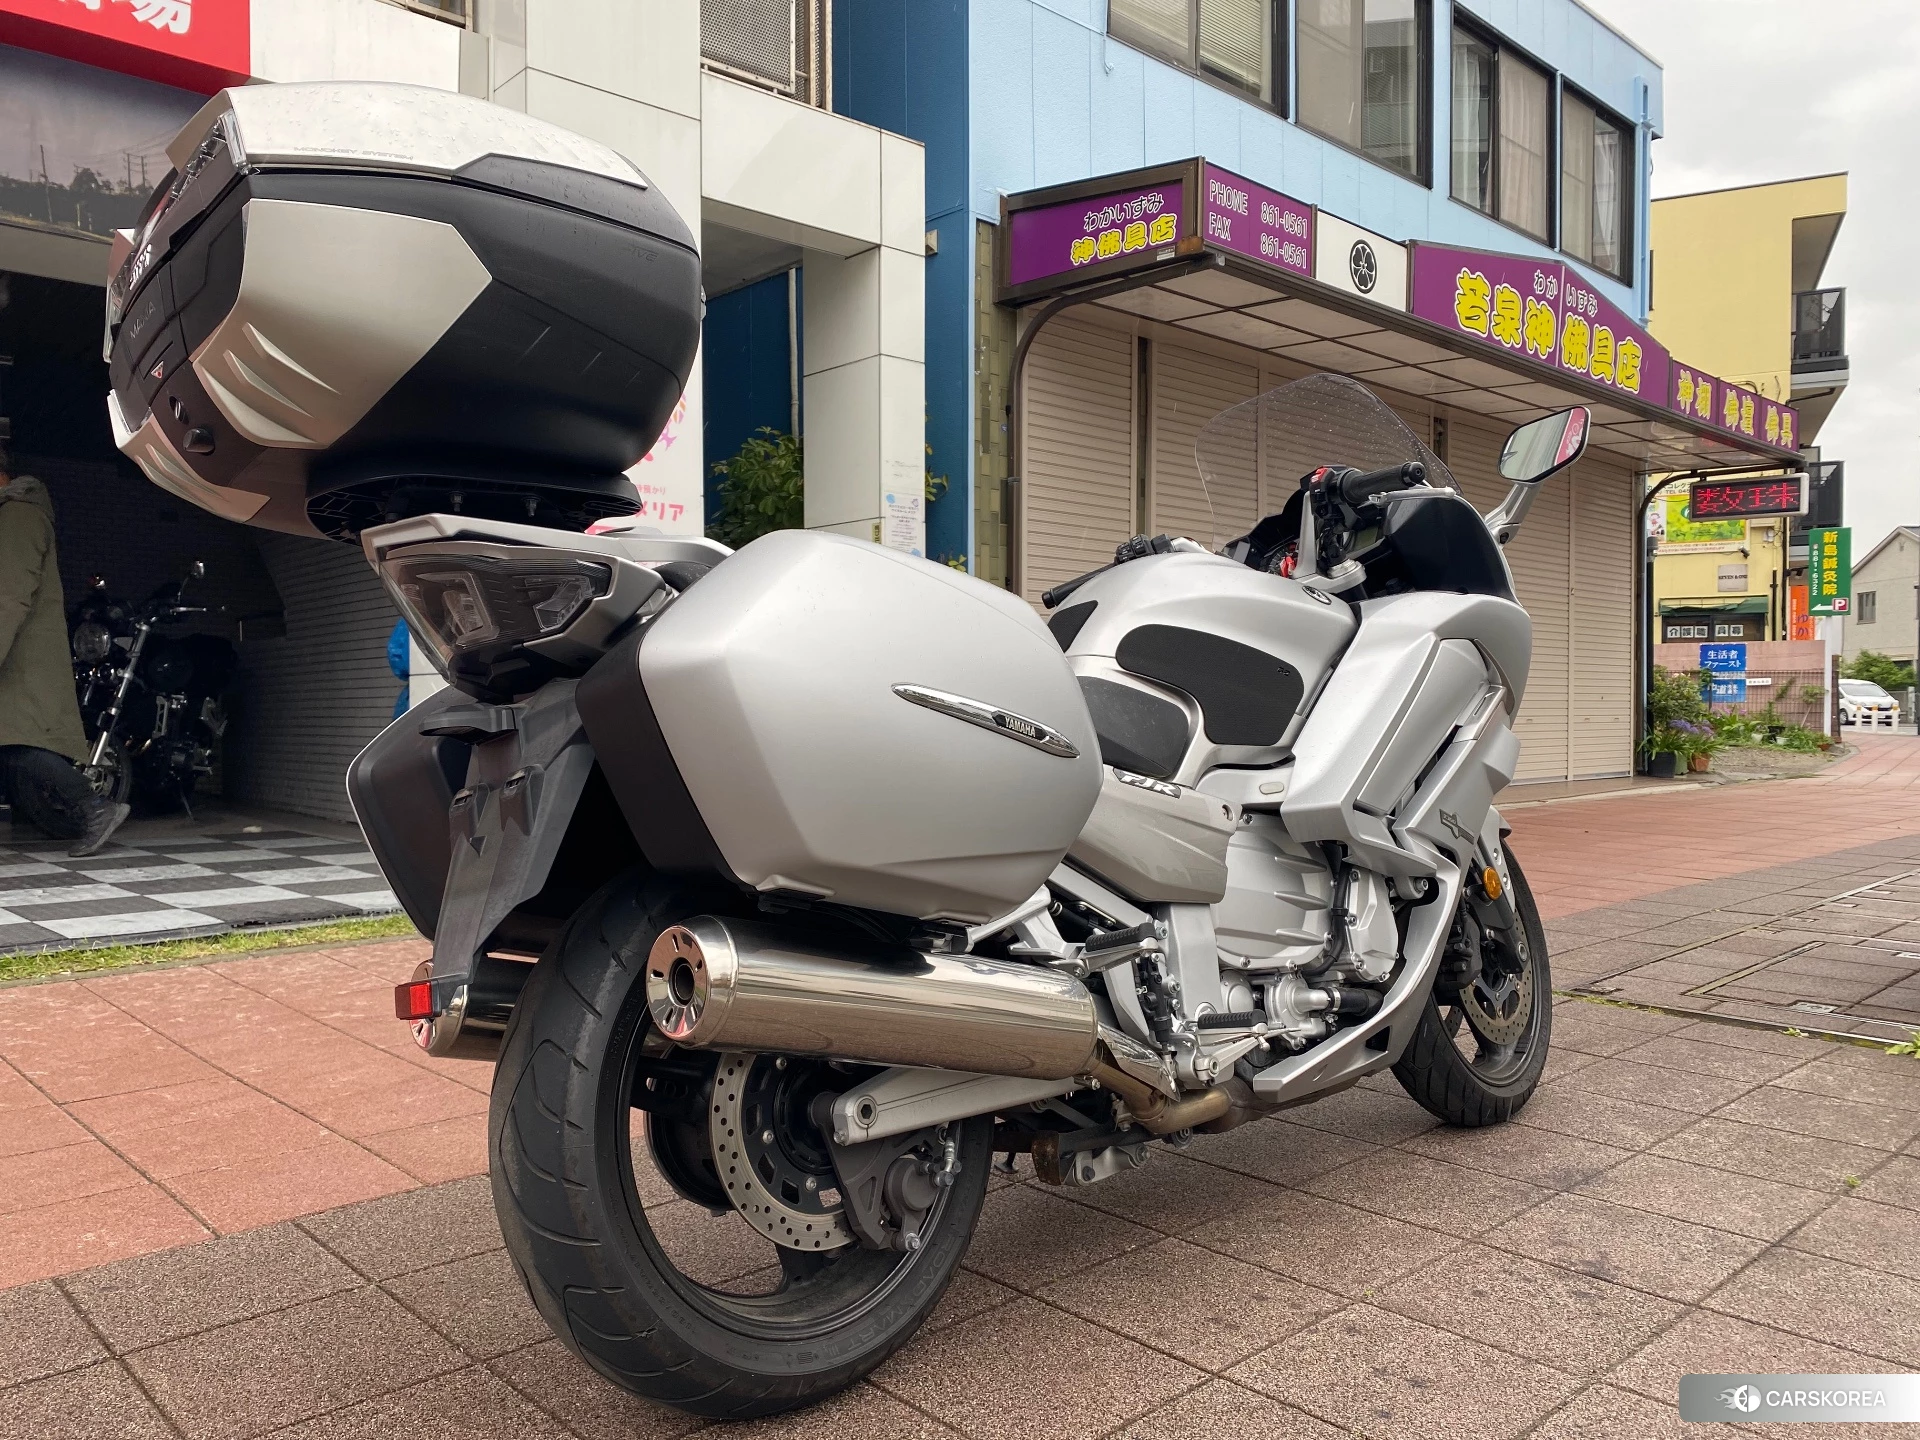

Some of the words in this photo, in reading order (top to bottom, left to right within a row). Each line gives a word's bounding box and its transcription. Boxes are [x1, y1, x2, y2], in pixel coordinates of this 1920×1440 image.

[1083, 192, 1165, 232] わかいずみ
[1209, 179, 1248, 216] PHONE
[1261, 201, 1308, 239] 861-0561
[1070, 213, 1178, 265] 神佛具店
[1208, 211, 1232, 241] FAX
[1260, 232, 1307, 269] 861-0561
[1676, 368, 1713, 420] 神棚
[1696, 481, 1800, 514] 数珠
[1822, 531, 1839, 596] 新島鍼灸院
[1834, 599, 1847, 611] P
[1704, 660, 1742, 669] ファースト
[1707, 649, 1738, 659] 生活者
[1004, 716, 1037, 738] YAMAHA
[1119, 773, 1177, 797] FJR
